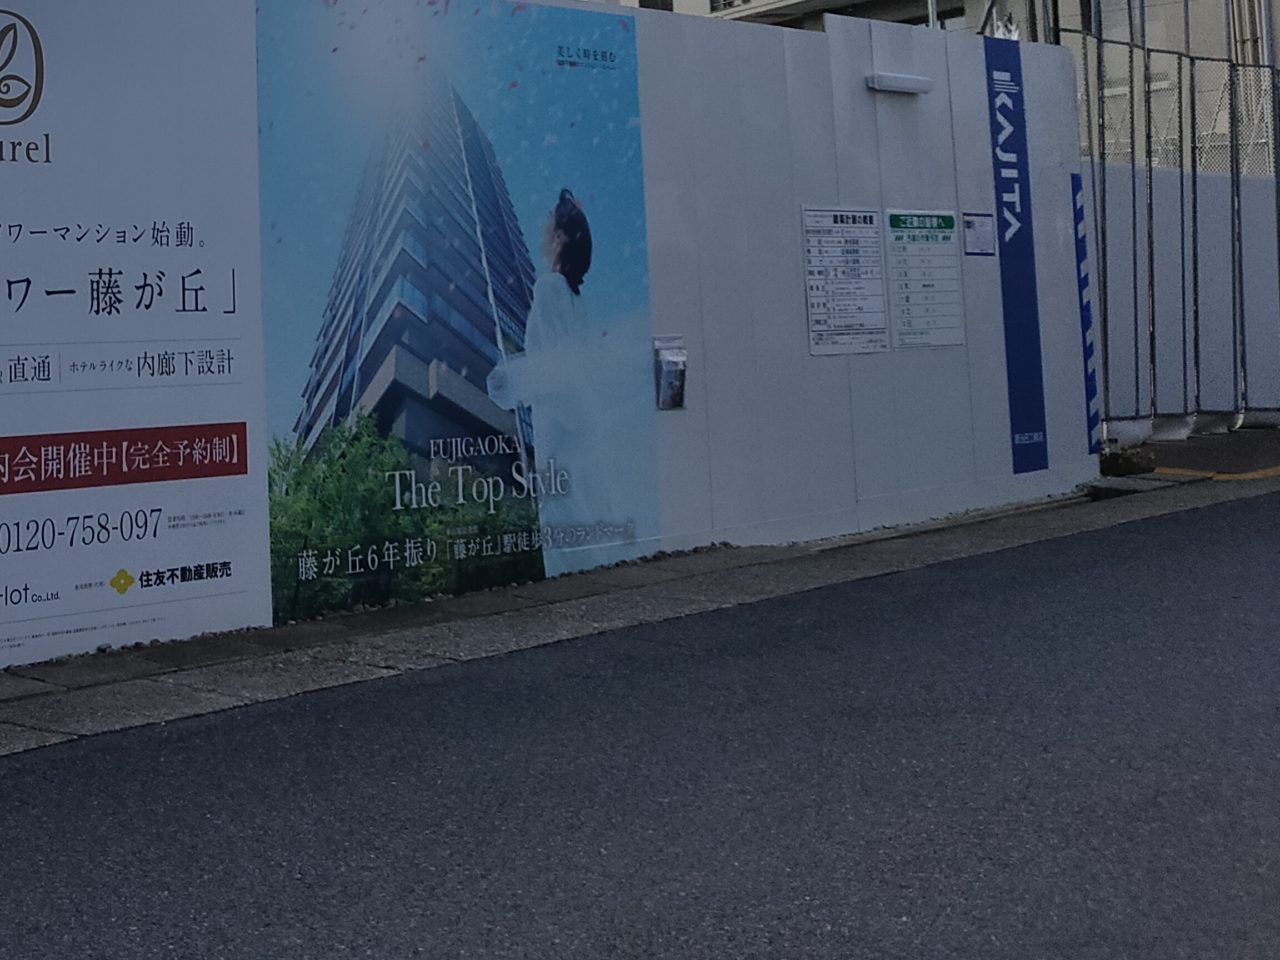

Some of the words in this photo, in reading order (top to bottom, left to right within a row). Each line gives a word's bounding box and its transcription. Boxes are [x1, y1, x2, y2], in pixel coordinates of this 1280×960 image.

[8, 354, 52, 384] 直通
[69, 358, 133, 374] ホテルライクな
[136, 348, 235, 378] 内廊下設計
[429, 435, 522, 464] FUJIGAOKA
[385, 470, 442, 511] The
[448, 464, 505, 515] Top
[511, 458, 570, 502] Style
[297, 537, 437, 581] 藤が丘6年振り
[138, 561, 233, 589] 住友不動産販売
